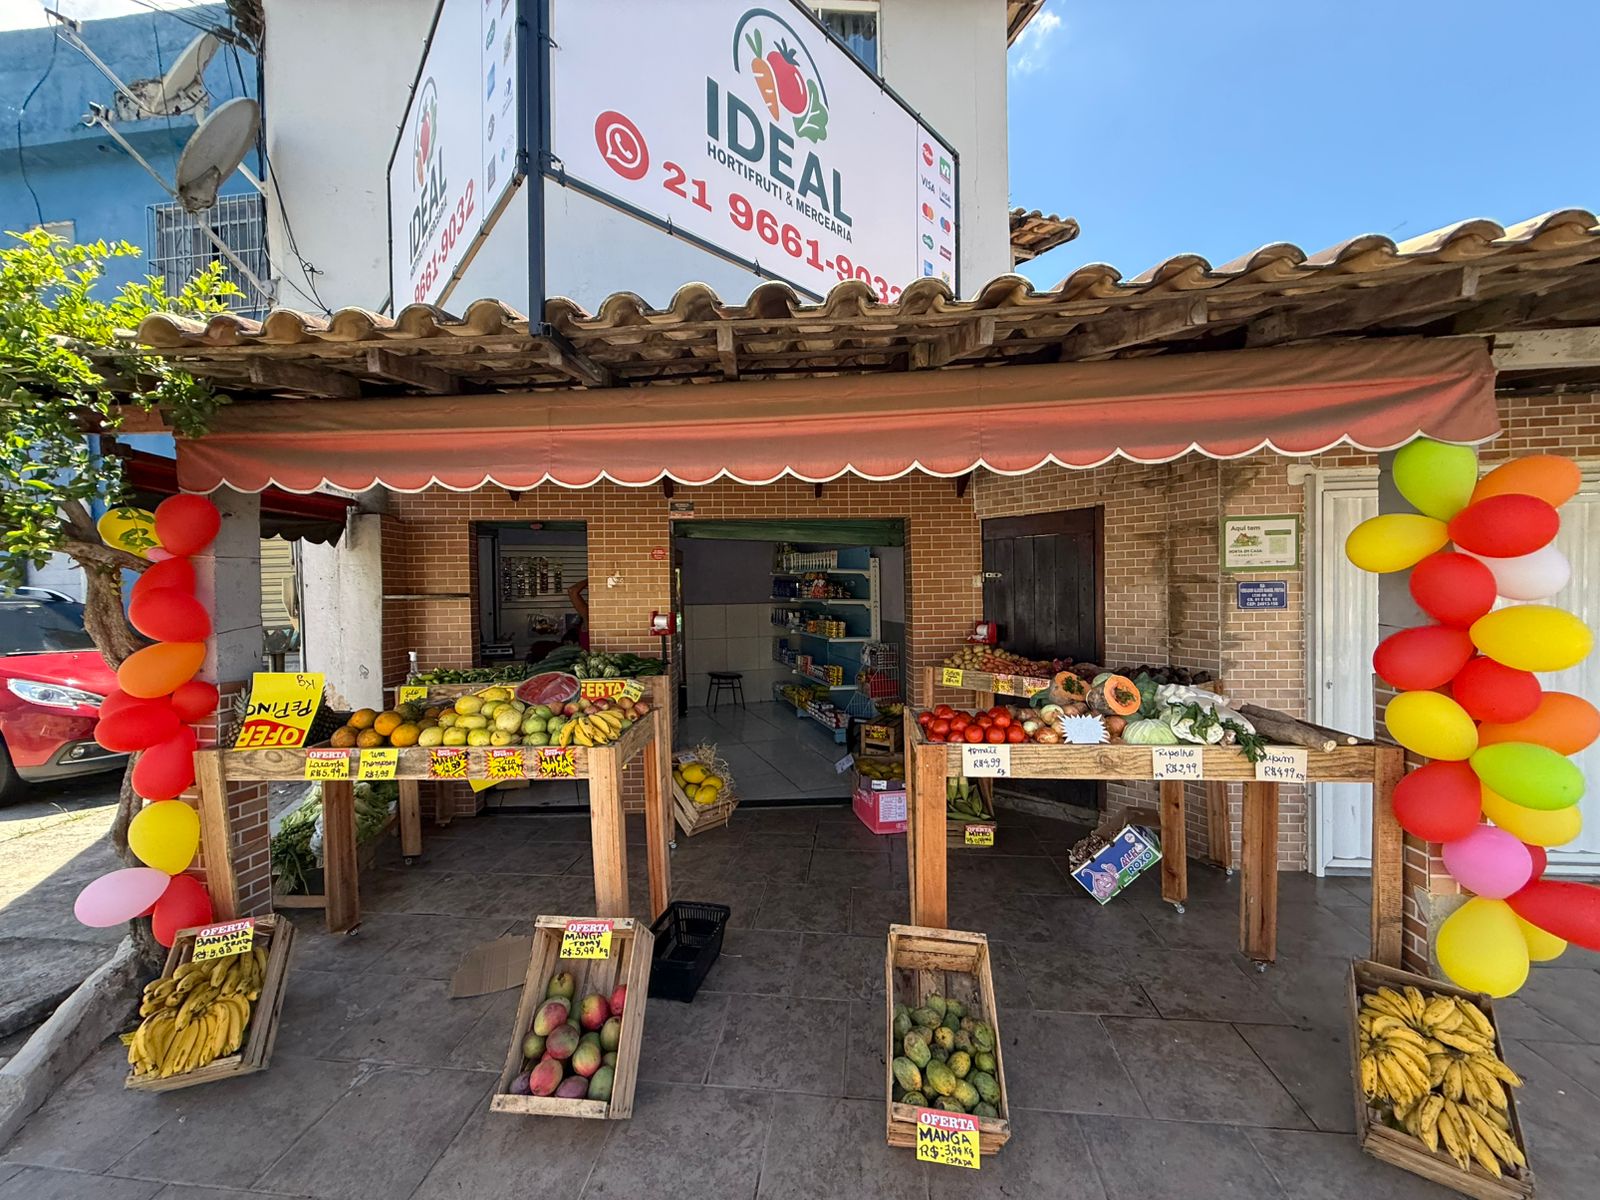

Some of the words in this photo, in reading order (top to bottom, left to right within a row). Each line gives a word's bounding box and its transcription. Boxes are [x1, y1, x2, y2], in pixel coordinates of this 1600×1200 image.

[706, 76, 852, 228] IDEAL
[662, 160, 713, 213] 21
[707, 141, 782, 201] HORTIFRUTI
[785, 190, 794, 207] &
[795, 197, 853, 244] MERCEARIA
[921, 175, 936, 195] VISA
[408, 146, 448, 266] IDEAL
[309, 751, 347, 759] OFERTA
[1259, 751, 1295, 764] ipim
[1126, 851, 1153, 875] ROXO
[200, 921, 250, 937] OFERTA
[564, 931, 603, 941] MANGA
[568, 923, 610, 932] OFERTA
[196, 930, 250, 948] BANANA
[920, 1112, 976, 1131] OFERTA
[918, 1127, 972, 1146] MANGA
[945, 1156, 974, 1168] ESPADA
